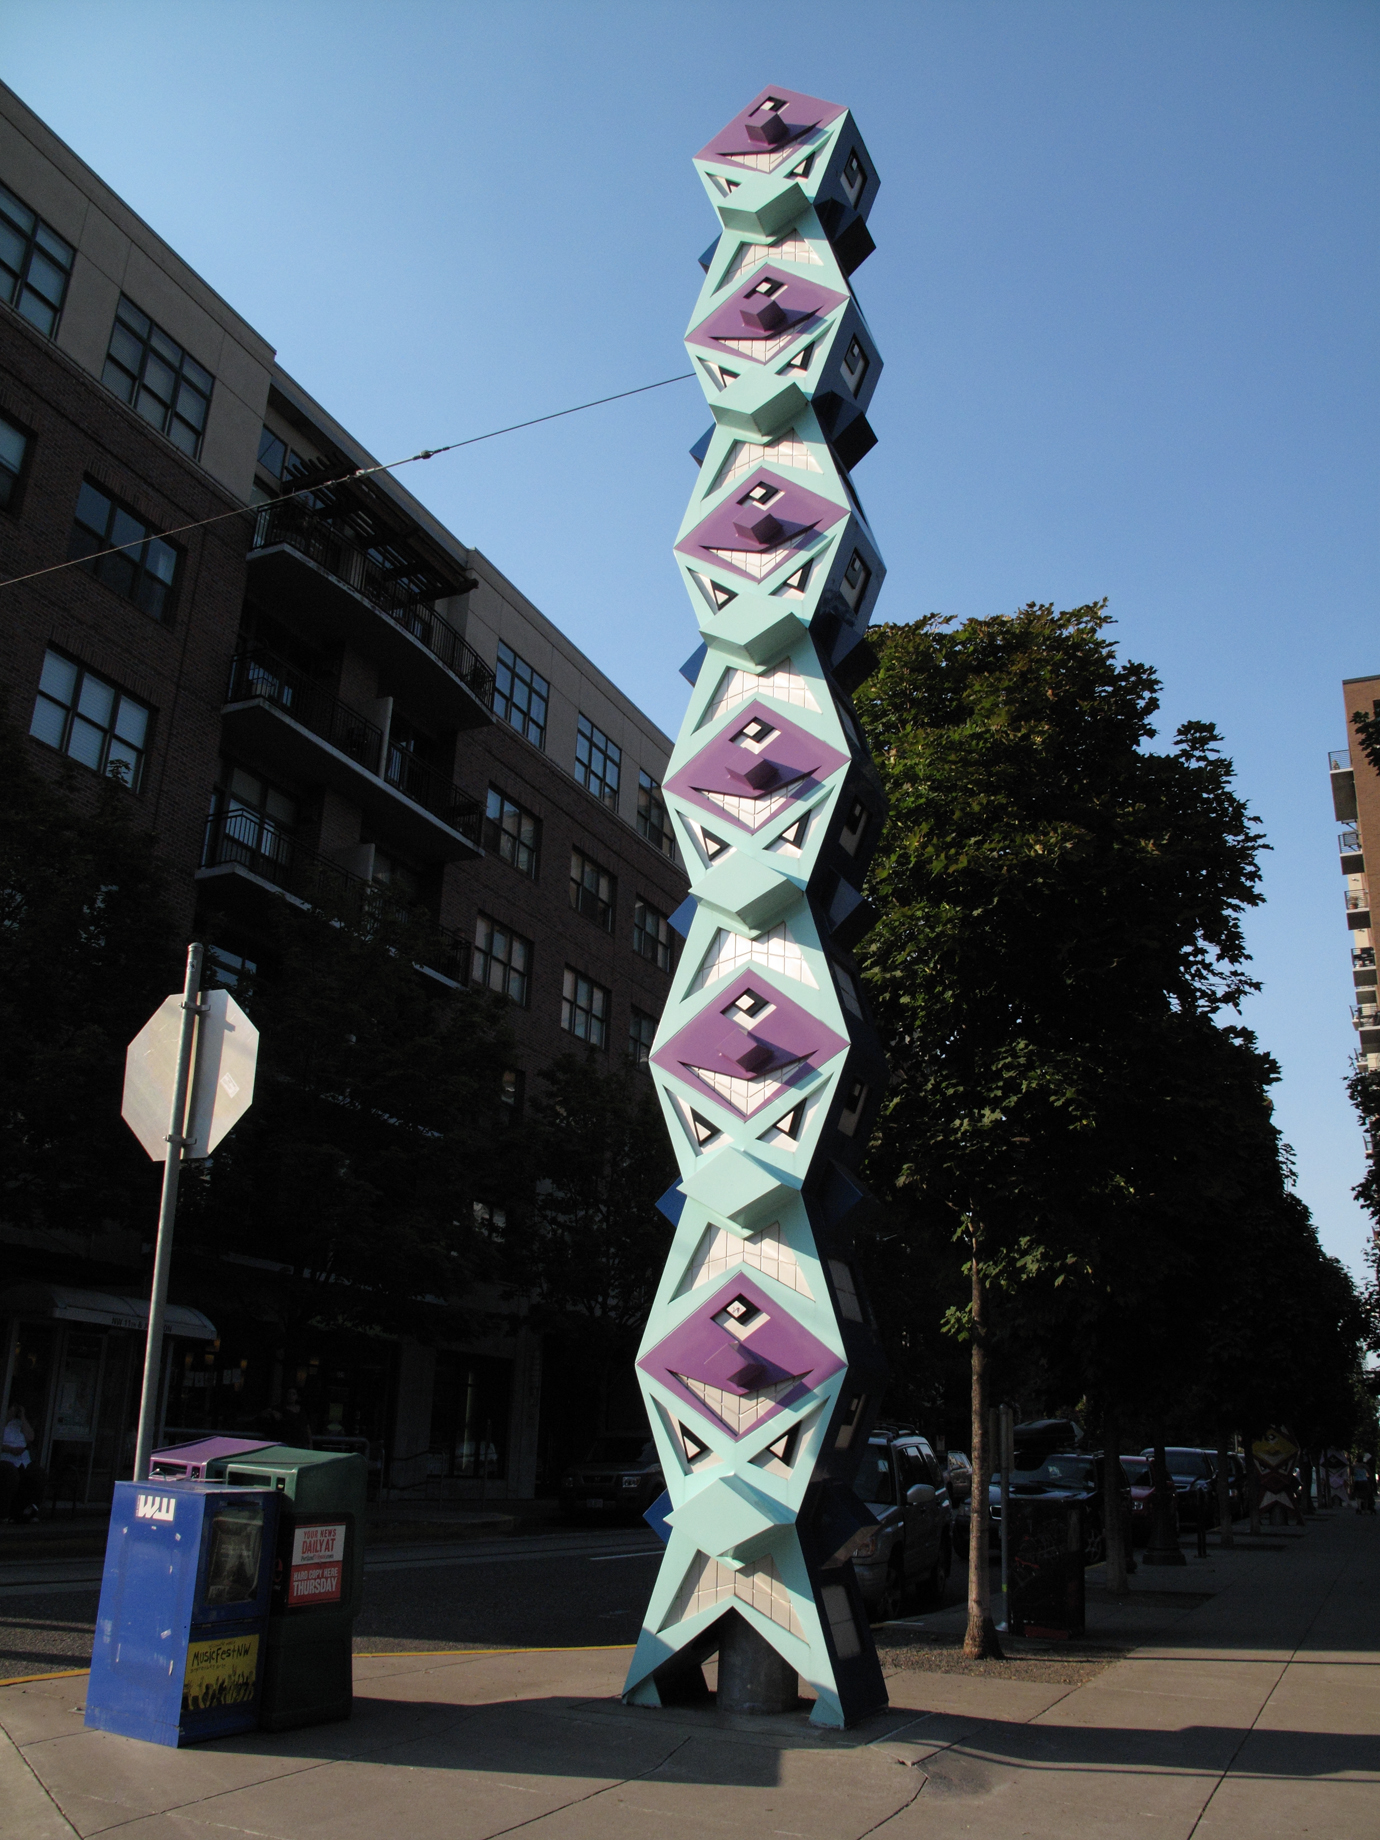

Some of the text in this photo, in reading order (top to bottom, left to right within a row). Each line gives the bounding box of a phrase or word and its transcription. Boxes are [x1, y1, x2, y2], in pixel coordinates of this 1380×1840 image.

[112, 1317, 123, 1326] NW
[304, 1529, 336, 1539] YOUR NEWS
[302, 1538, 335, 1554] DAILY AT
[293, 1567, 338, 1581] HARD COPY HERE
[293, 1578, 337, 1596] THURSDAY
